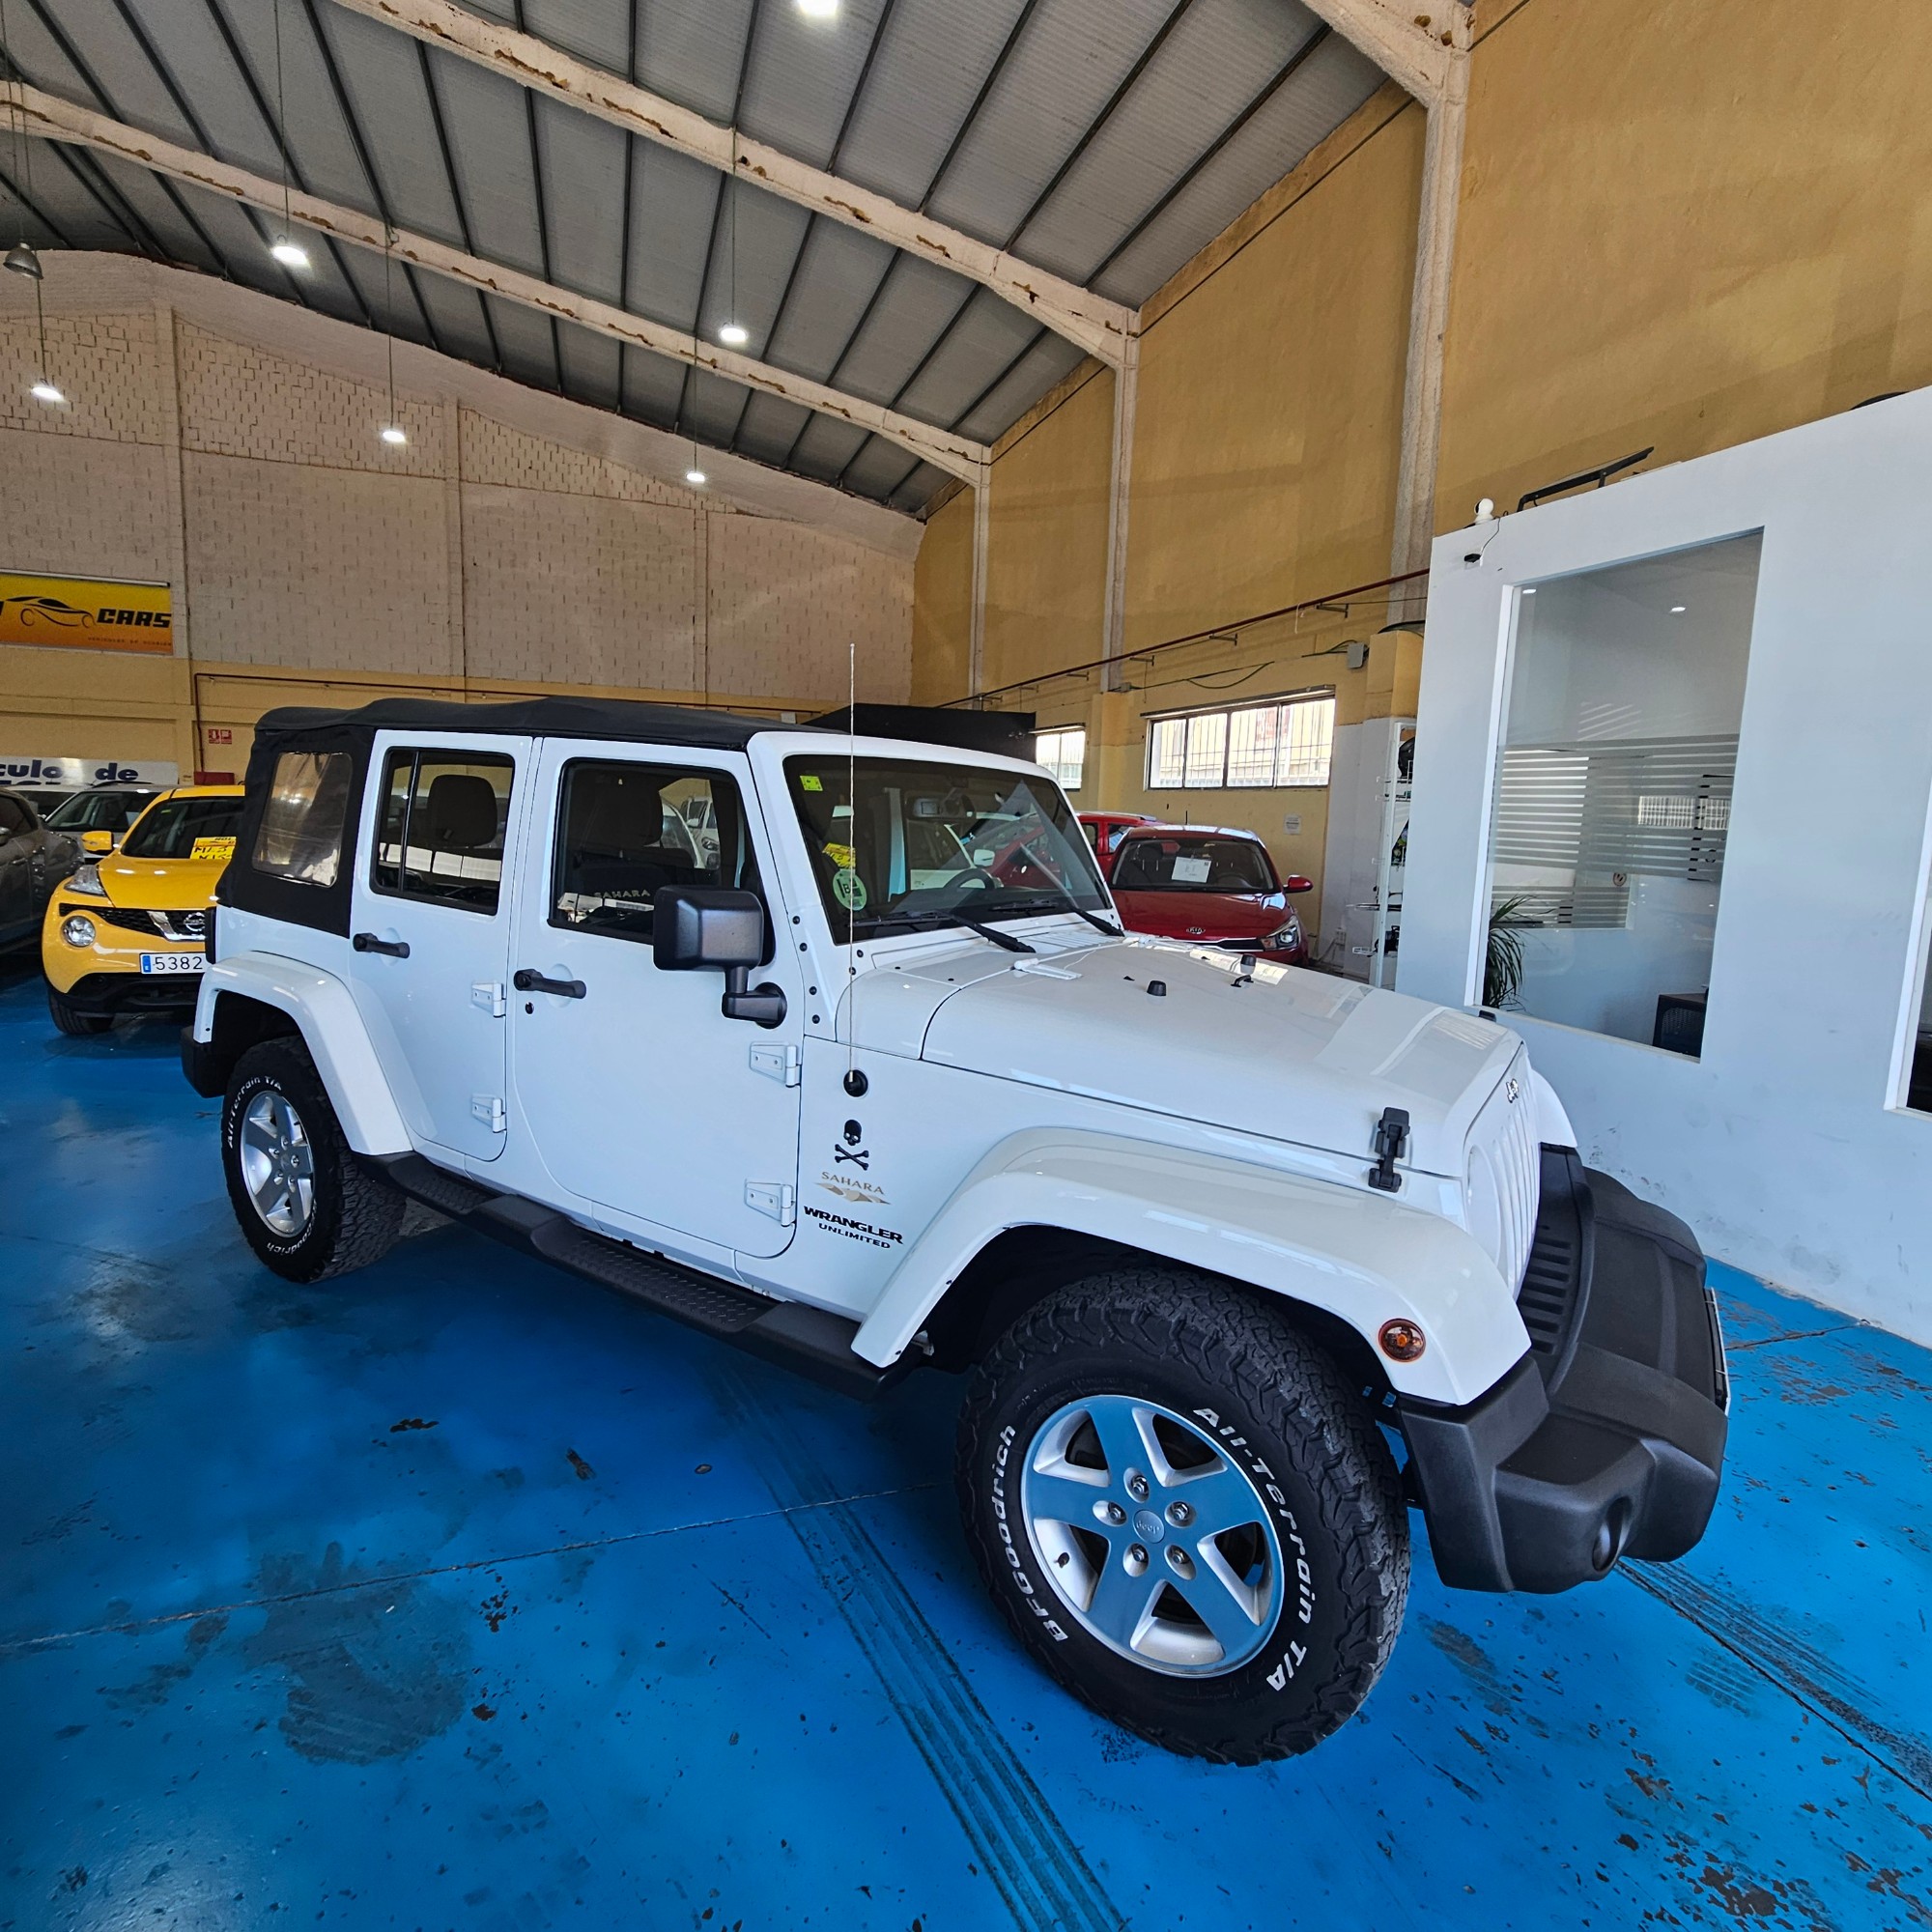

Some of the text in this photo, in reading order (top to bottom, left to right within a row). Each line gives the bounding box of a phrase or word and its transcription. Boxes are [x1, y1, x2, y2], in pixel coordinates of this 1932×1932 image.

[97, 608, 172, 628] CARS
[95, 762, 139, 781] de
[593, 889, 651, 898] SAHARA
[155, 956, 203, 970] 5382
[821, 1171, 885, 1195] SAHARA
[803, 1205, 904, 1245] WRANGLER
[818, 1222, 891, 1249] UNLIMITED
[991, 1424, 1069, 1642] BFGoodrich
[1192, 1407, 1316, 1691] All-Terrain T/A
